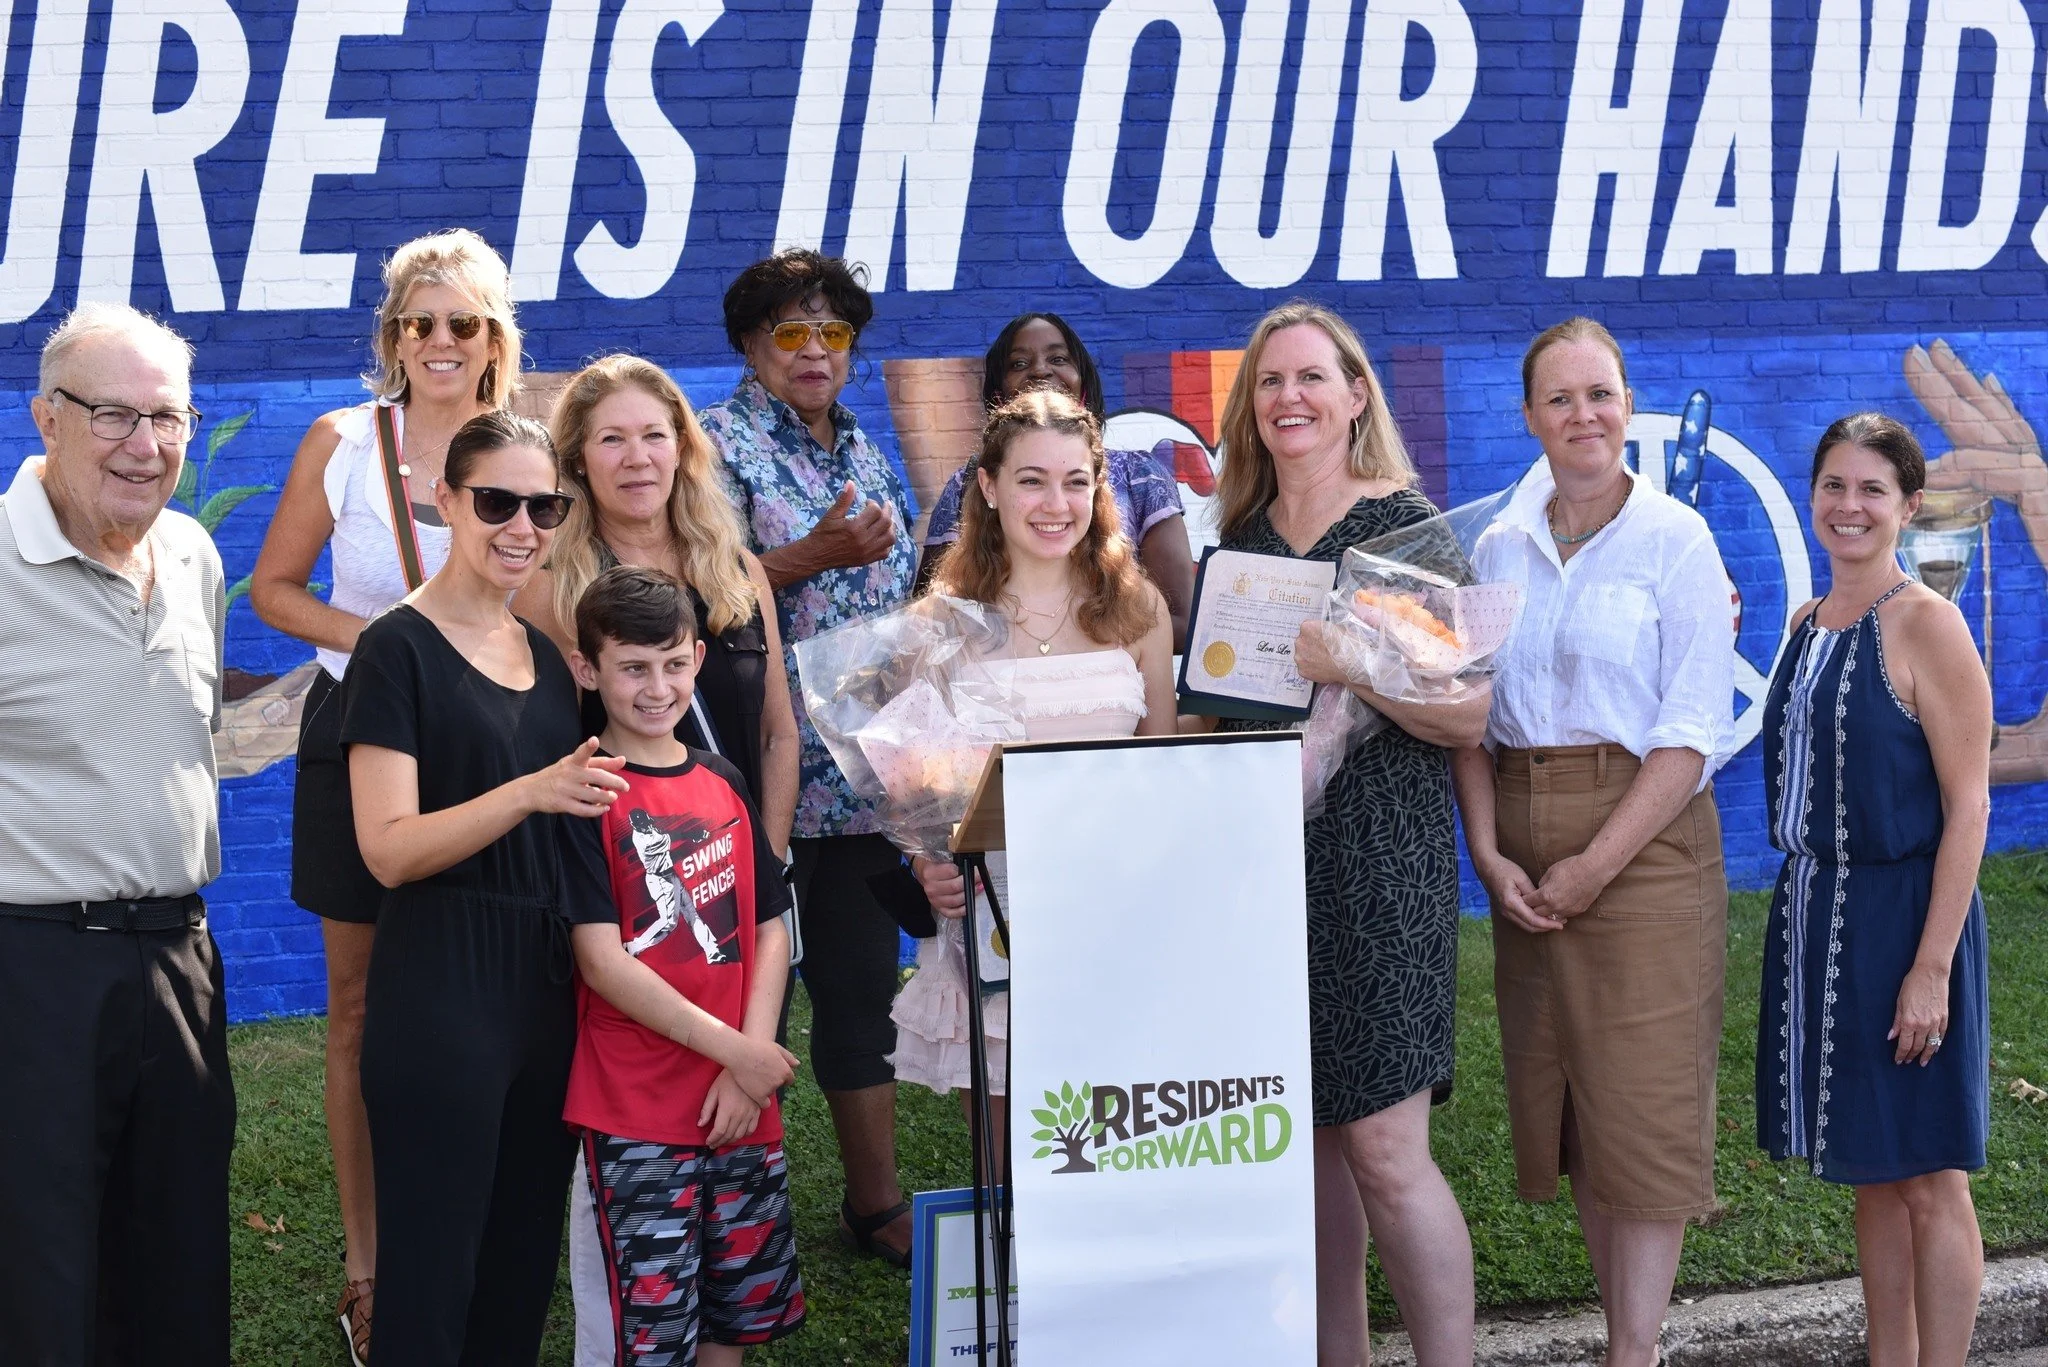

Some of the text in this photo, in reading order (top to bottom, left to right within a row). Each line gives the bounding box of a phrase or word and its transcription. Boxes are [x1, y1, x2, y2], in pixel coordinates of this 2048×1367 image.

[514, 0, 724, 303] IS
[774, 0, 999, 292] IN
[1063, 0, 1477, 290] OUR
[1545, 0, 2048, 278] HAND
[1268, 588, 1312, 606] Citation
[682, 832, 733, 879] SWING
[716, 859, 728, 870] THE
[692, 864, 736, 908] FENCES
[1092, 1075, 1285, 1149] RESIDENTS
[1097, 1103, 1292, 1173] FORWARD
